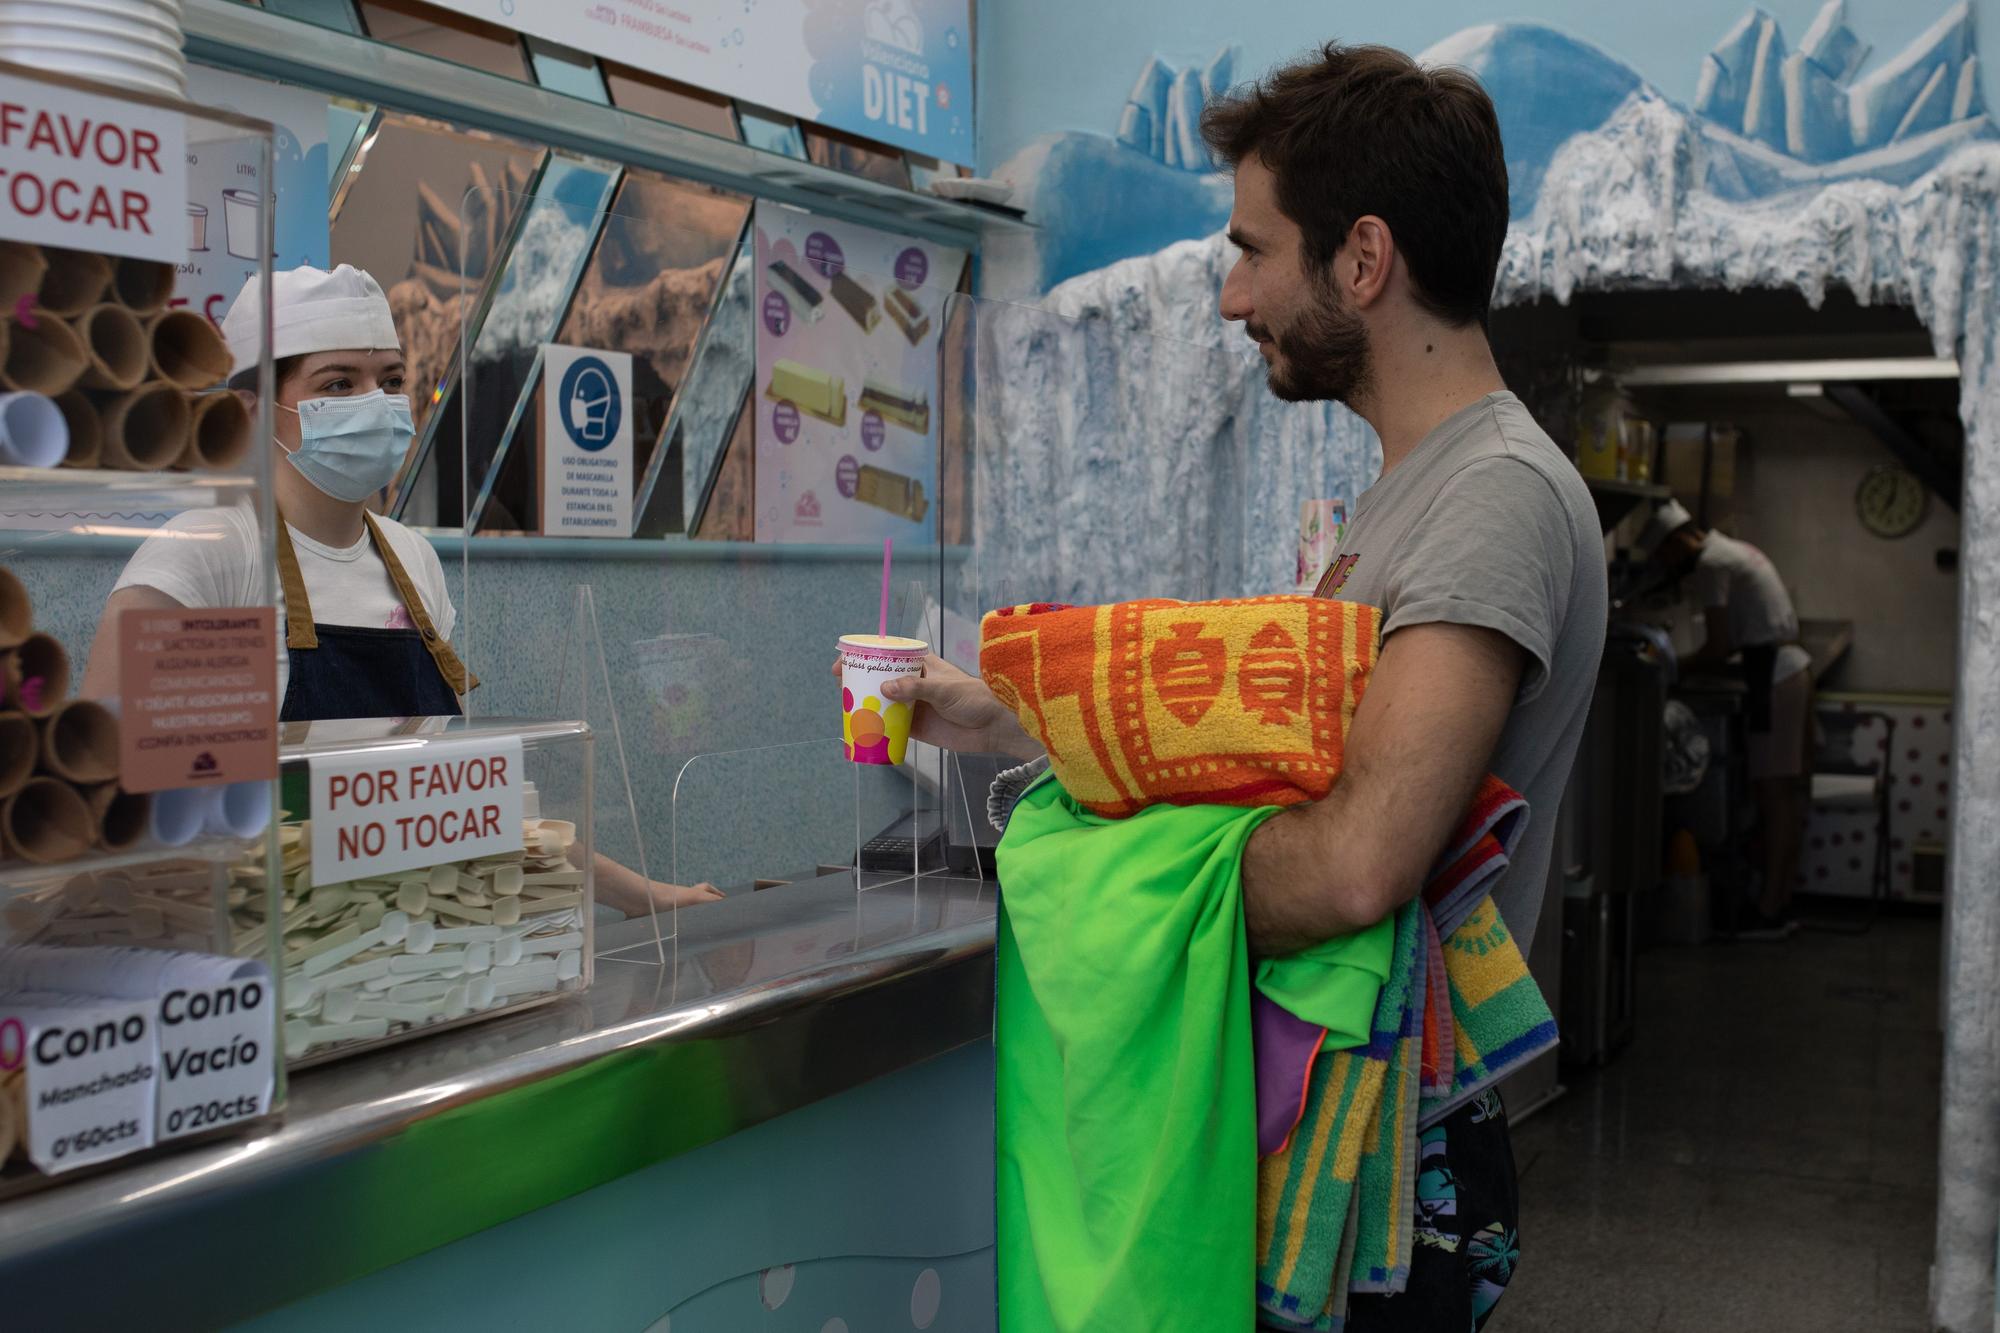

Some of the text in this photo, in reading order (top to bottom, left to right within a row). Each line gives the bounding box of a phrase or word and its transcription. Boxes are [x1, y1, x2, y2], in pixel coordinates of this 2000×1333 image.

[862, 64, 930, 135] DIET
[0, 102, 162, 174] FAVOR
[566, 471, 614, 482] DE MASCARILLA
[577, 456, 618, 468] OBLIGATORIO
[561, 486, 618, 498] DURANTE TODA LA
[561, 516, 618, 528] ESTABLECIMIENTO
[181, 618, 261, 631] INTOLERANTE
[848, 659, 865, 671] glass
[867, 662, 893, 674] gelato
[894, 664, 906, 673] ice
[329, 756, 509, 811] POR FAVOR
[338, 804, 501, 861] NO TOCAR
[160, 981, 263, 1026] Cono
[34, 1014, 145, 1066] Cono
[163, 1033, 260, 1081] Vacío
[36, 1062, 154, 1111] Manchado
